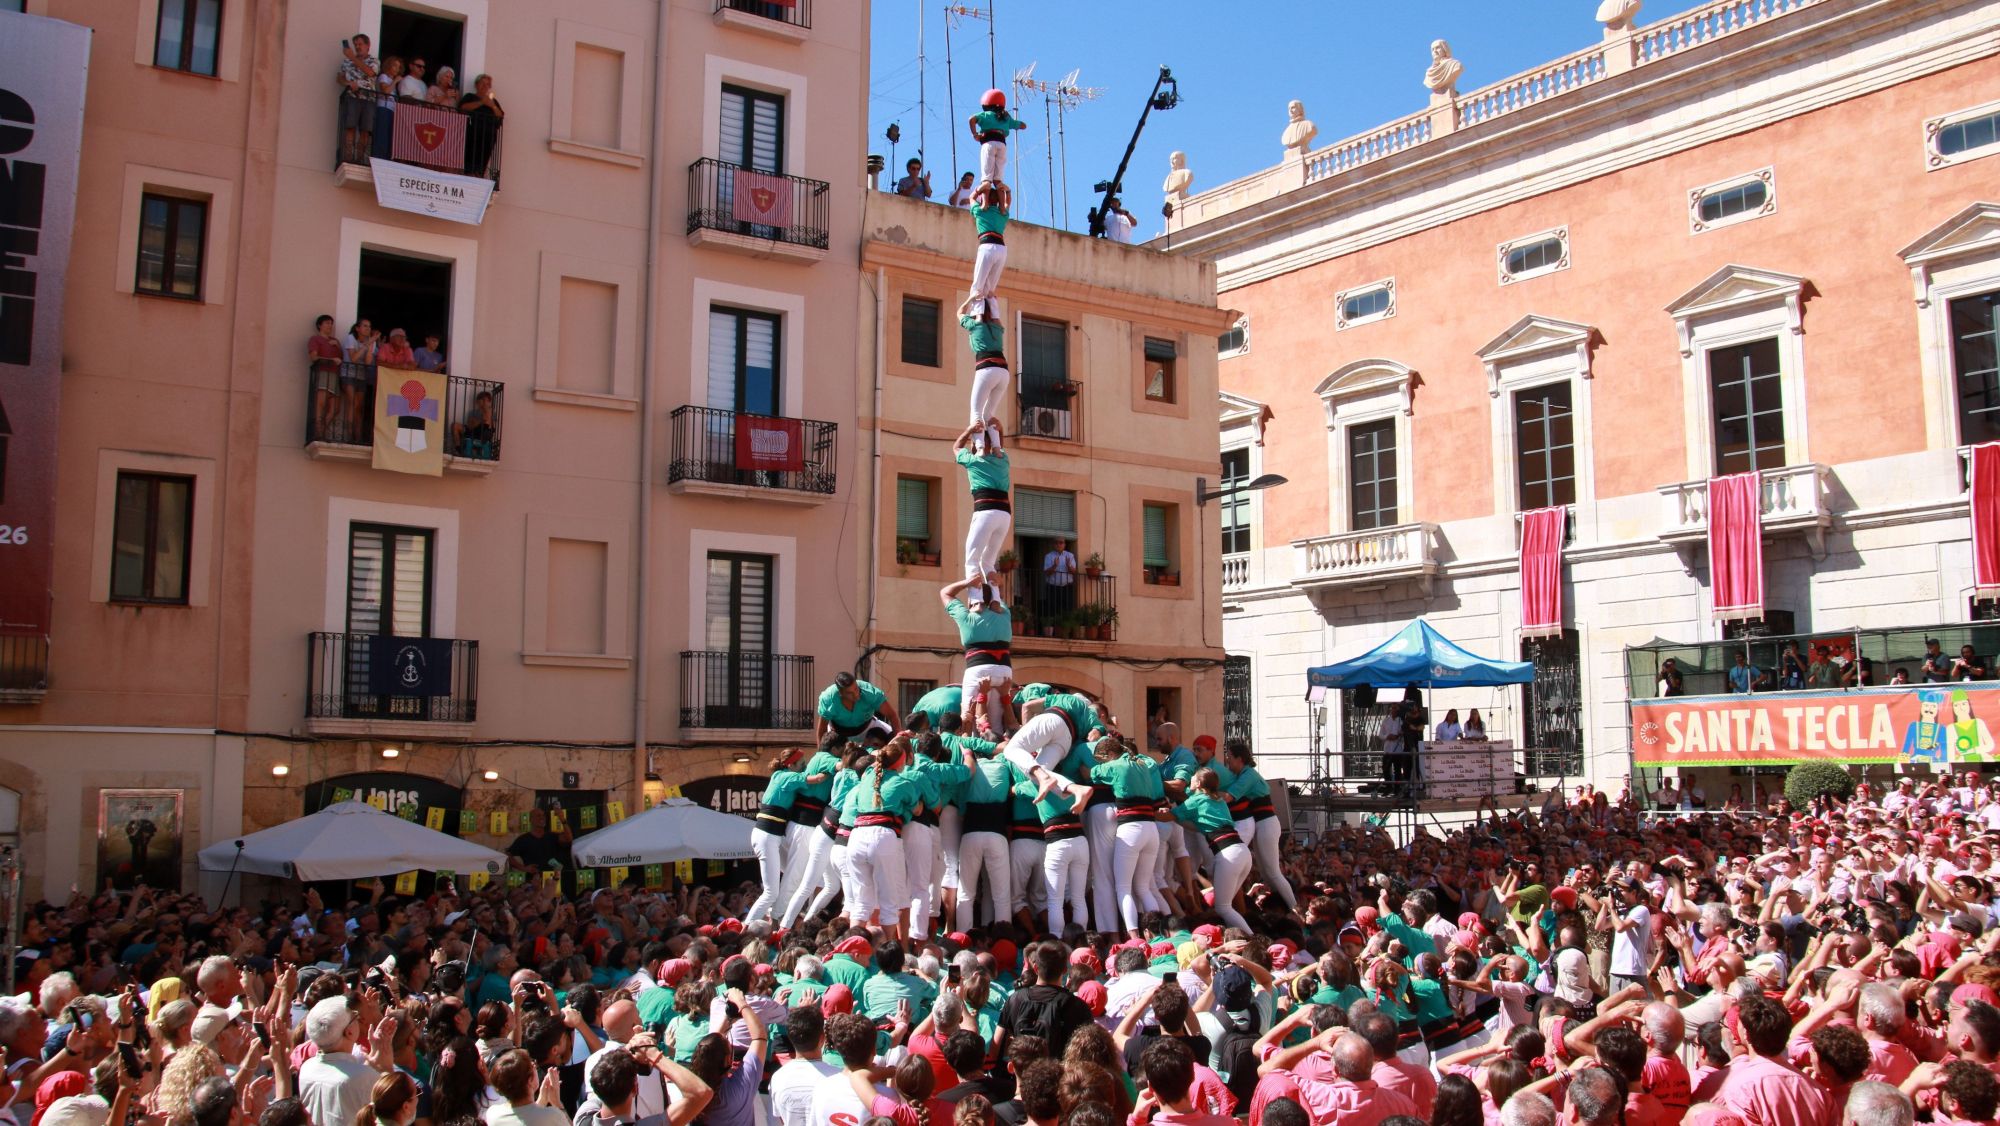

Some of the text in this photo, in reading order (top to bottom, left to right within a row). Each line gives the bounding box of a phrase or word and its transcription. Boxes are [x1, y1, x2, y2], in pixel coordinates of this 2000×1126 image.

[1665, 704, 1896, 753] SANTA TECLA
[710, 789, 721, 811] 4
[599, 853, 642, 865] Alhambra
